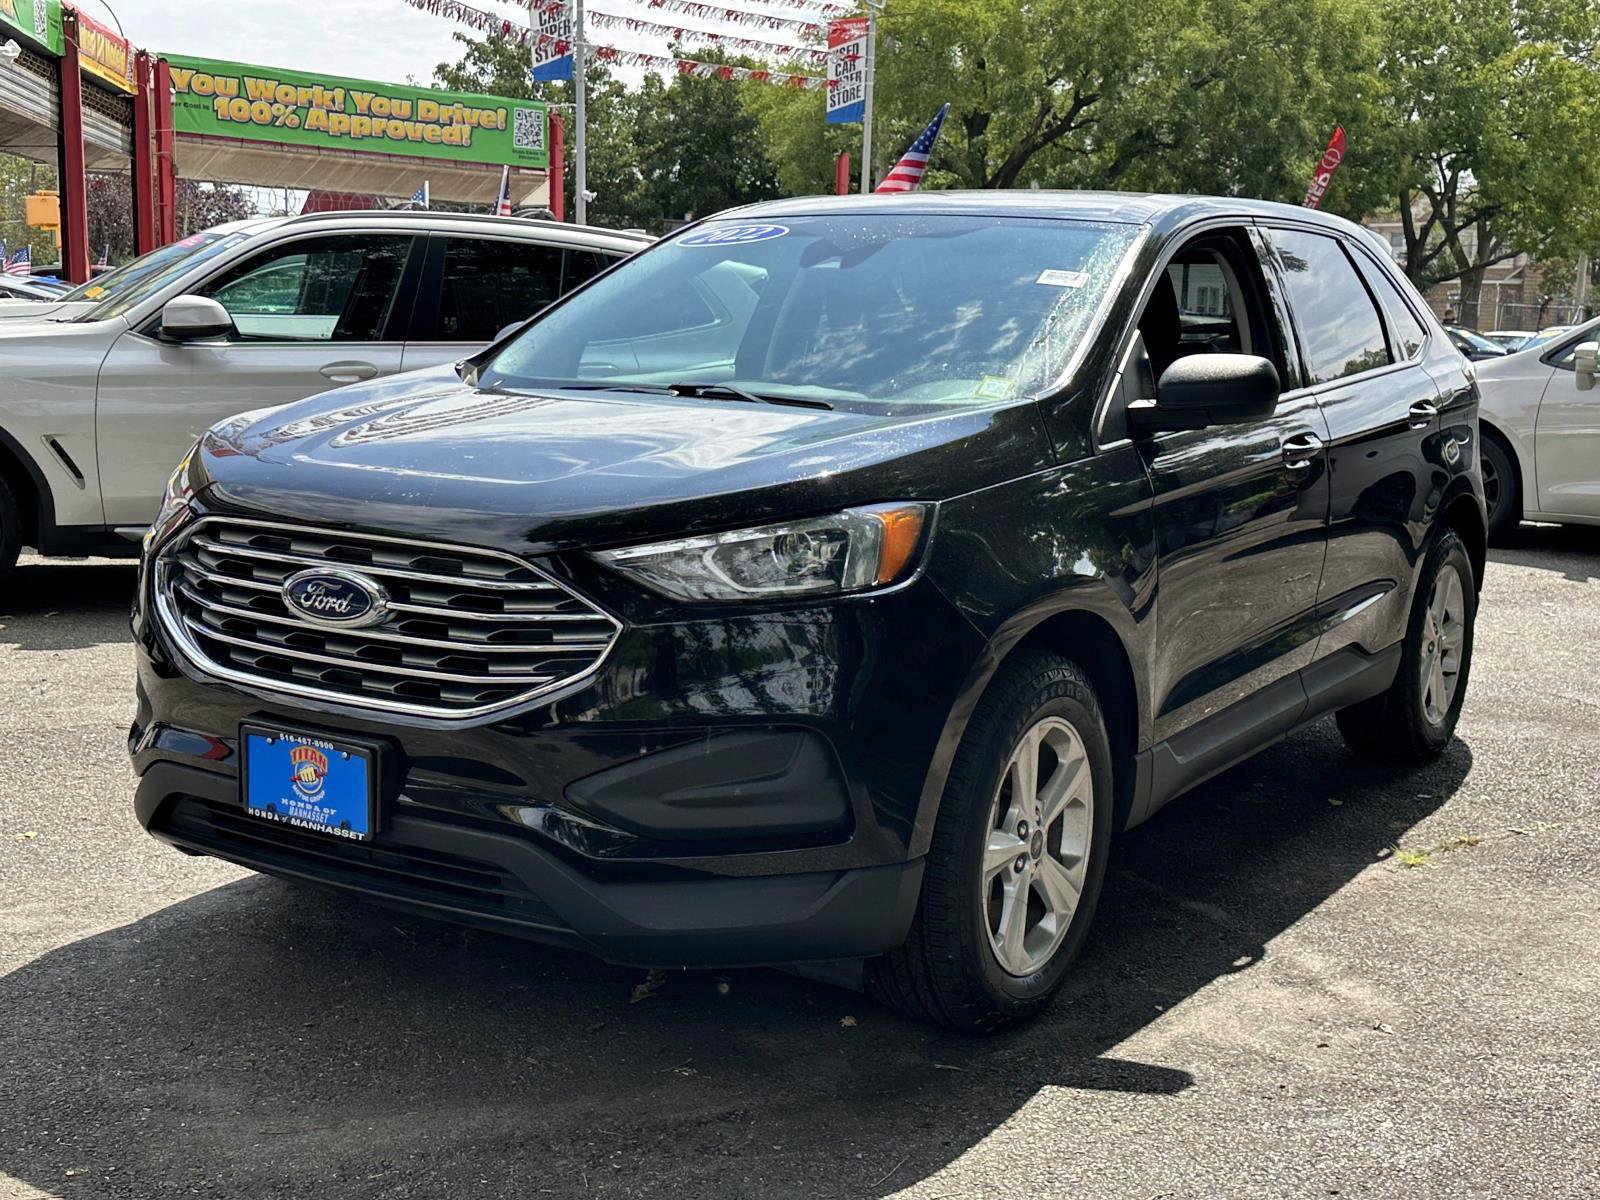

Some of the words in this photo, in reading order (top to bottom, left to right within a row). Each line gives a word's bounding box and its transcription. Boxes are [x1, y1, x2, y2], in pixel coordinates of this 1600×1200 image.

[534, 36, 571, 62] STOE
[835, 59, 856, 77] CAR
[169, 67, 241, 97] You
[242, 75, 345, 111] Work!
[349, 89, 413, 120] You
[417, 99, 508, 131] Drive!
[829, 85, 861, 108] STORE
[213, 96, 301, 129] 100%
[303, 107, 473, 147] Approved!
[687, 227, 775, 244] 2022
[300, 580, 354, 614] Ford
[290, 746, 328, 772] TITAN
[281, 798, 320, 812] HONDA
[288, 806, 329, 824] MANHASSET
[248, 808, 280, 822] HONDA
[290, 817, 365, 841] MANHASSET
